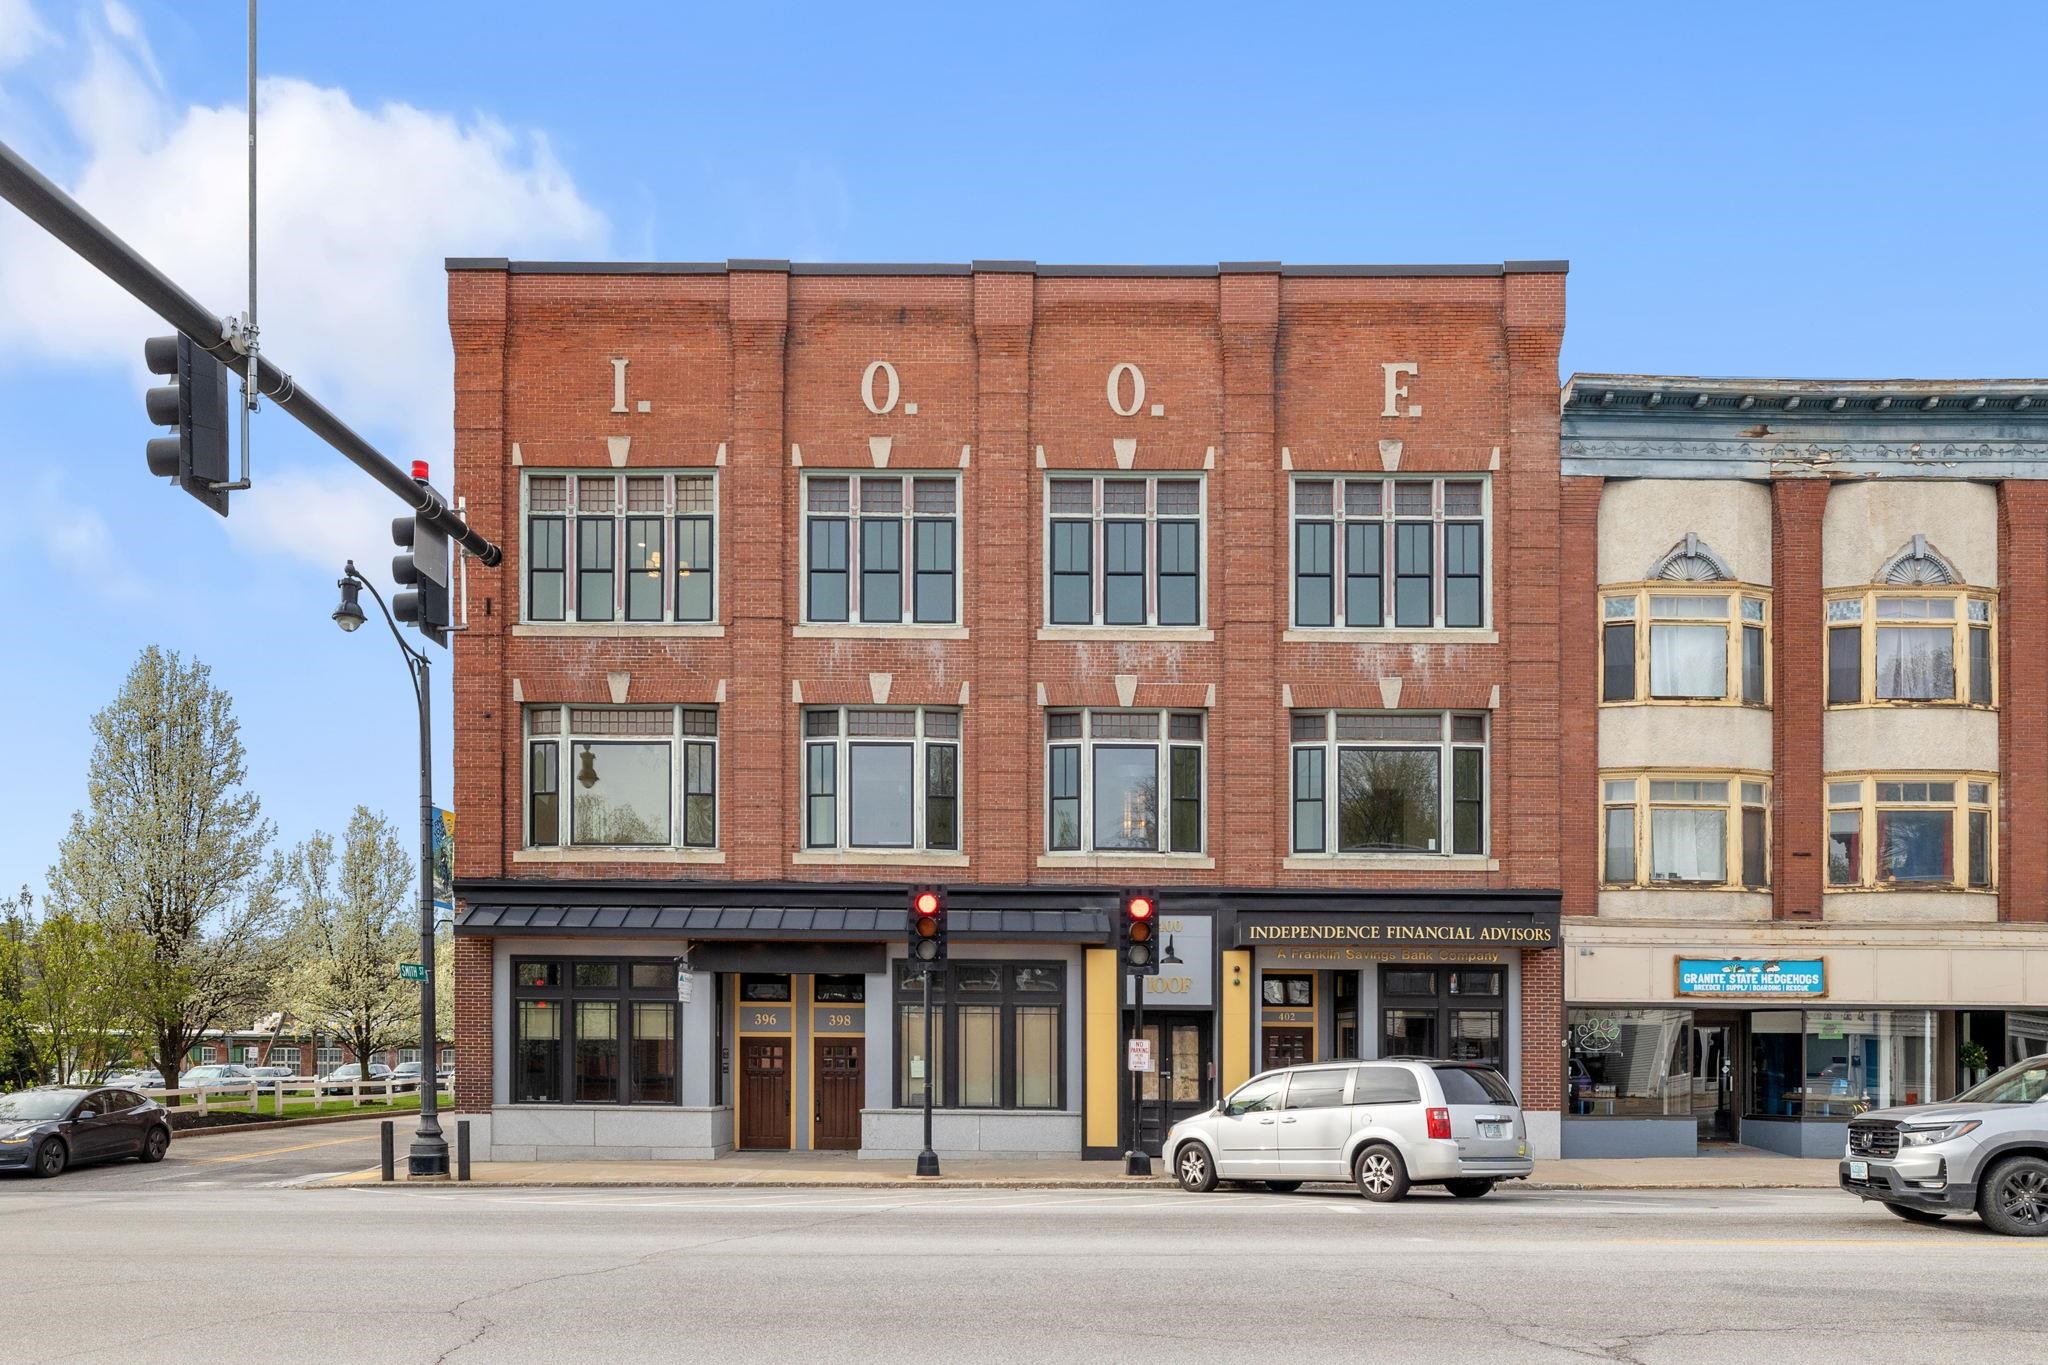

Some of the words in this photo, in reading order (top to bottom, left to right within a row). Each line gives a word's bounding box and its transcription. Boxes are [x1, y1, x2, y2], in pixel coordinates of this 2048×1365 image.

[1380, 362, 1422, 417] F.
[1249, 926, 1380, 939] INDEPENDENCE
[1387, 926, 1475, 940] FINANCIAL
[1479, 927, 1552, 941] ADVISORS
[1277, 949, 1286, 959] A
[1291, 949, 1341, 960] Franklin
[1345, 949, 1396, 962] Savings
[1402, 950, 1433, 960] Bank
[1439, 950, 1499, 963] Company
[401, 965, 418, 978] SMITH
[1146, 976, 1192, 993] IOOF
[1683, 973, 1726, 984] GRANITE
[1729, 974, 1758, 984] STATE
[1761, 974, 1819, 985] HEDGEHOGS
[1753, 984, 1781, 992] BOARDING
[1786, 984, 1809, 992] RESCUE
[754, 1013, 777, 1025] 396
[829, 1014, 852, 1026] 398
[1278, 1012, 1296, 1021] 402
